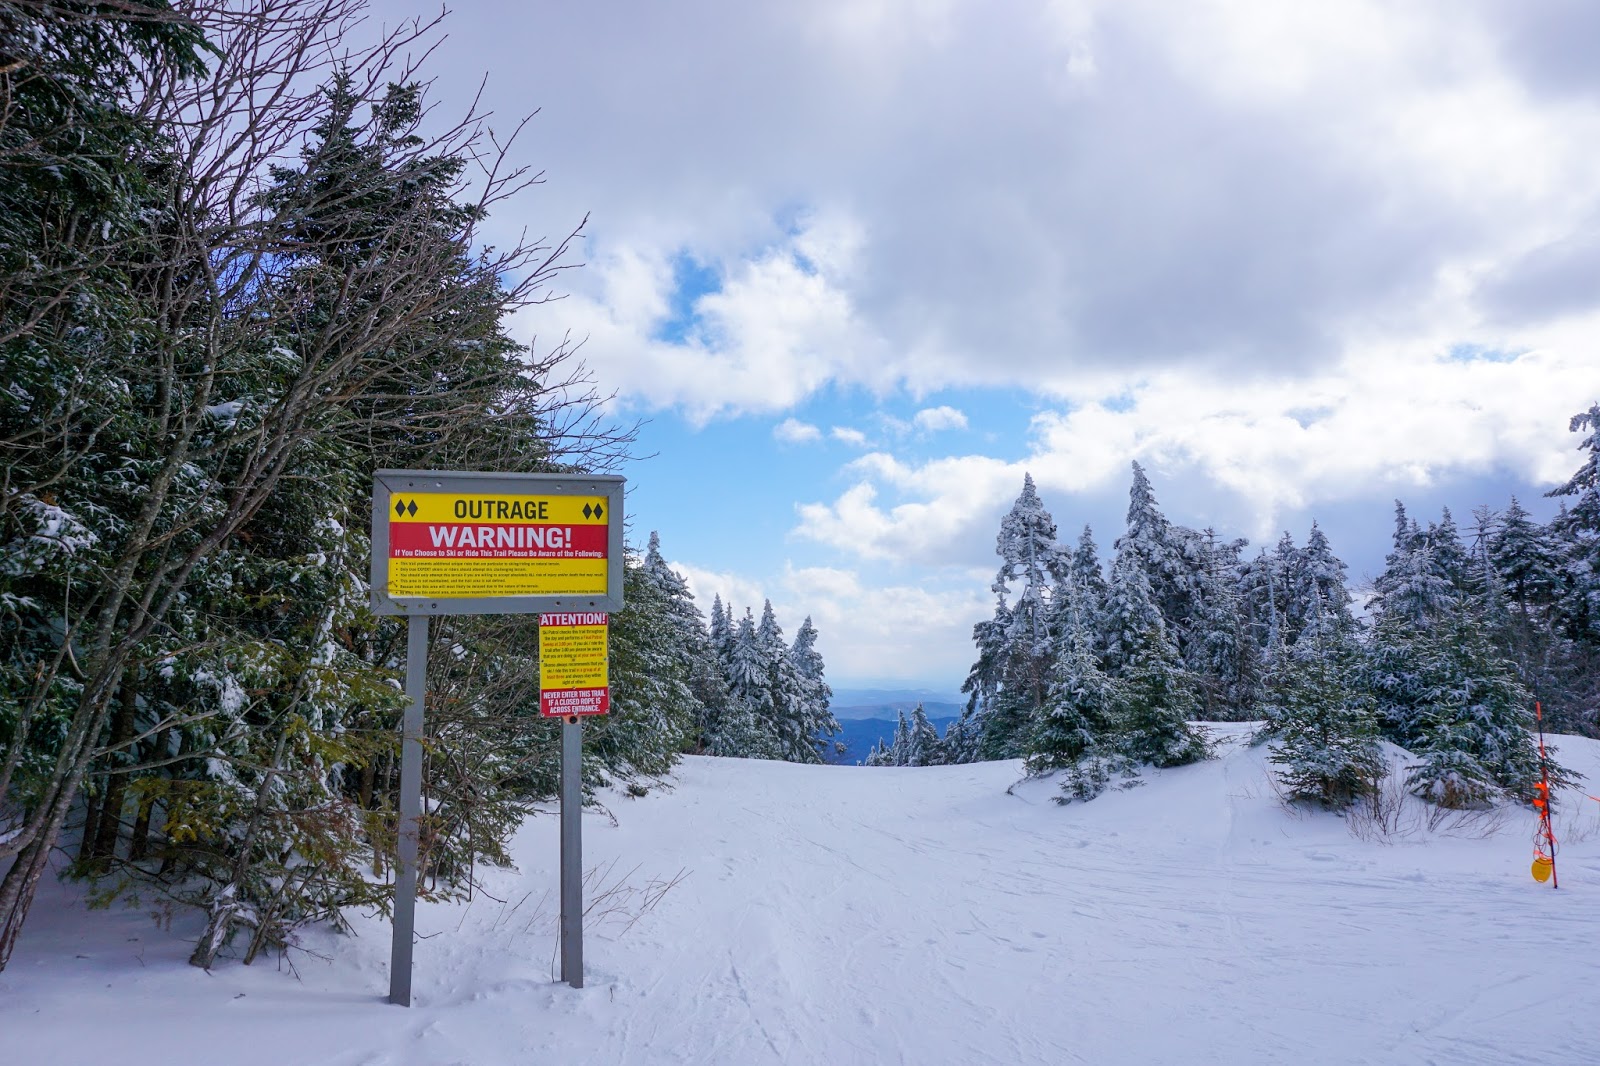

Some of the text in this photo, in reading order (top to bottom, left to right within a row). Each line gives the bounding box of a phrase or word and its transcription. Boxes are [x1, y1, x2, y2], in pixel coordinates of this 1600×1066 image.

[454, 500, 549, 520] OUTRAGE
[429, 526, 572, 548] WARNING!
[395, 549, 400, 557] If
[402, 549, 413, 557] You
[414, 549, 437, 557] Choose
[438, 549, 444, 557] to
[446, 549, 456, 557] Ski
[465, 549, 478, 557] Ride
[480, 549, 492, 557] This
[541, 613, 606, 625] ATTENTION!
[572, 705, 600, 713] ENTRANCE.
